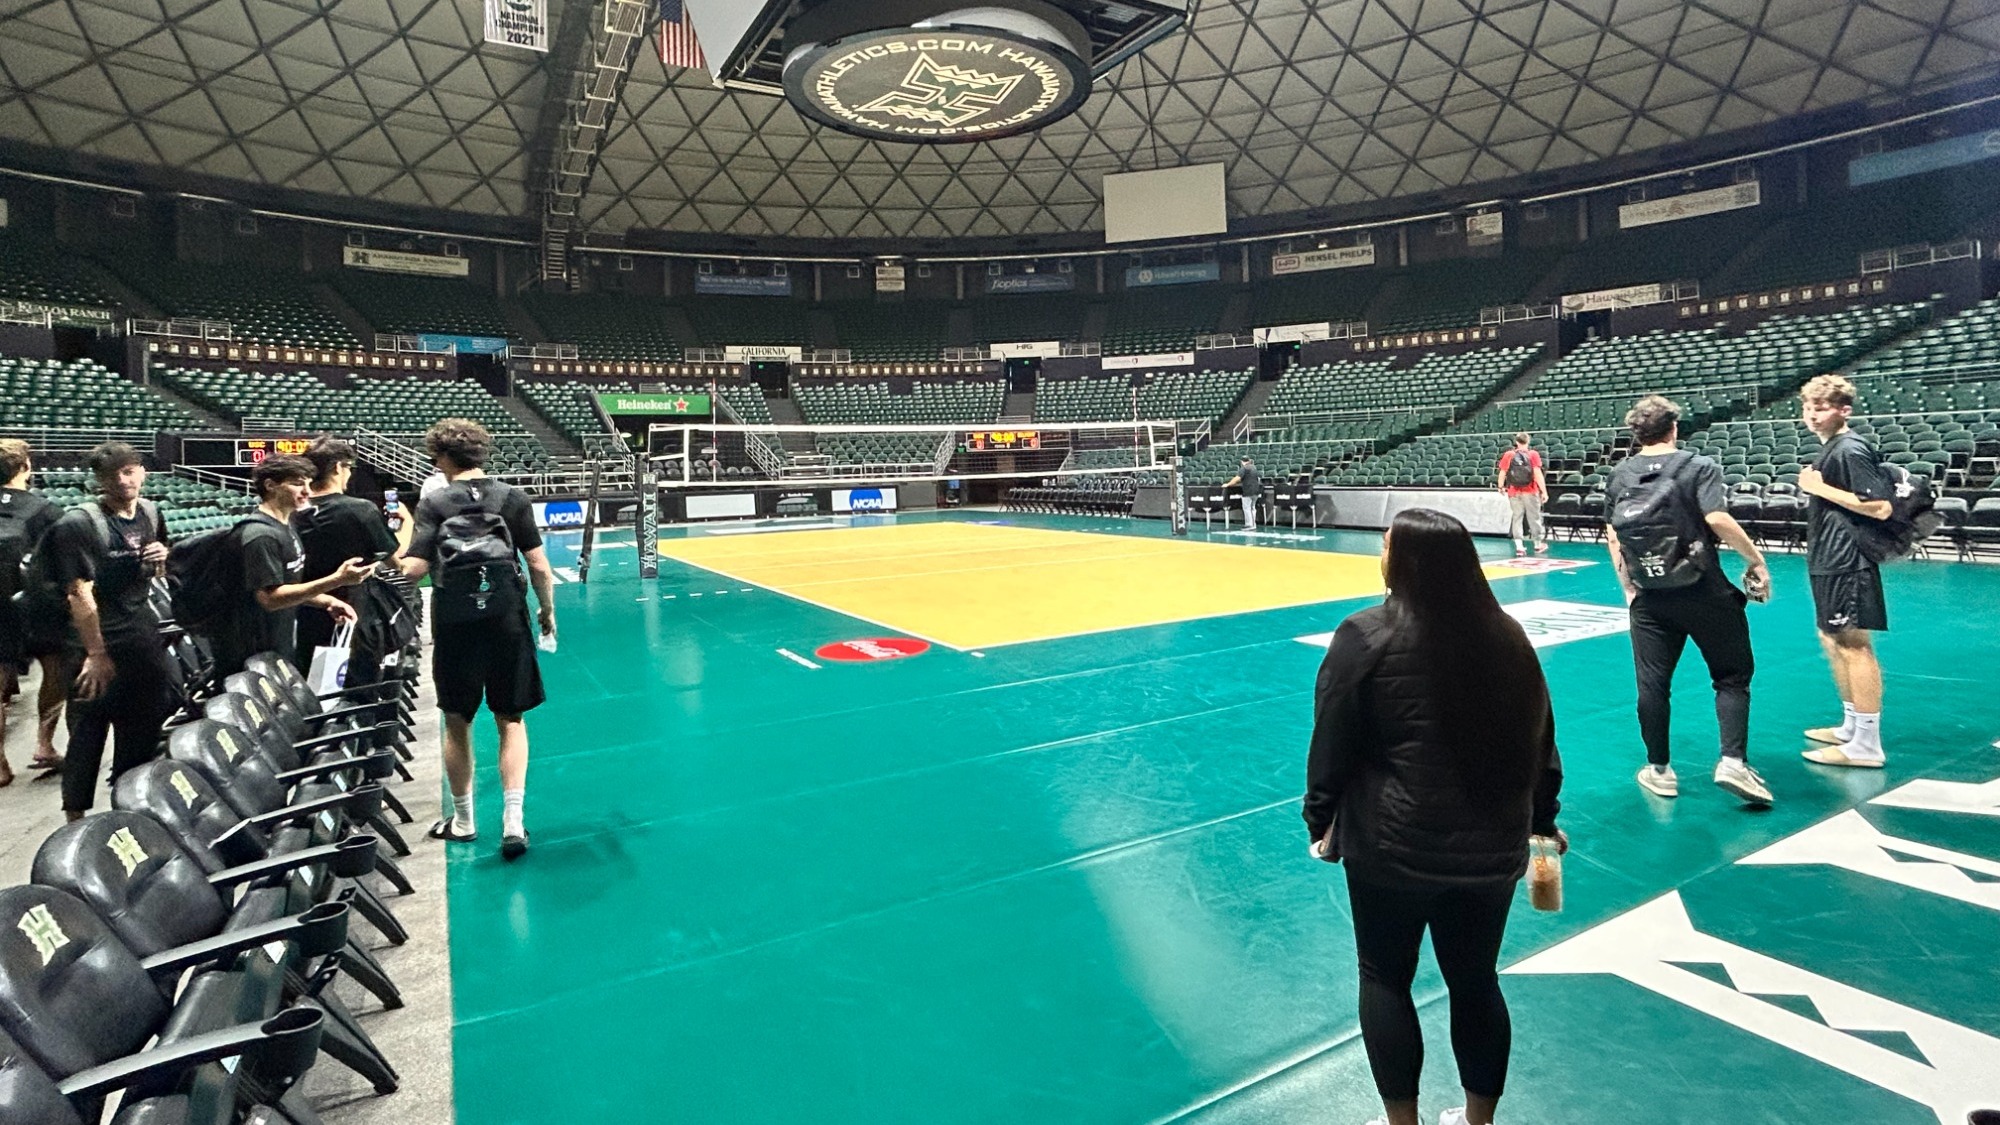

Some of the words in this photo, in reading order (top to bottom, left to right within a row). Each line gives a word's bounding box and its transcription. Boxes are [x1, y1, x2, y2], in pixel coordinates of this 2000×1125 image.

[500, 10, 539, 26] NATIONAL
[495, 19, 545, 35] CHAMPIONS
[507, 31, 534, 46] 2021
[1304, 252, 1338, 263] HENSEL
[1340, 248, 1372, 260] PHELPS
[70, 307, 110, 320] RANCH
[741, 346, 786, 356] CALIFORNIA
[617, 399, 671, 410] Heineken
[852, 498, 882, 509] NCAA
[549, 512, 583, 524] NCAA
[641, 491, 657, 569] HAWAII
[1645, 565, 1665, 577] 13
